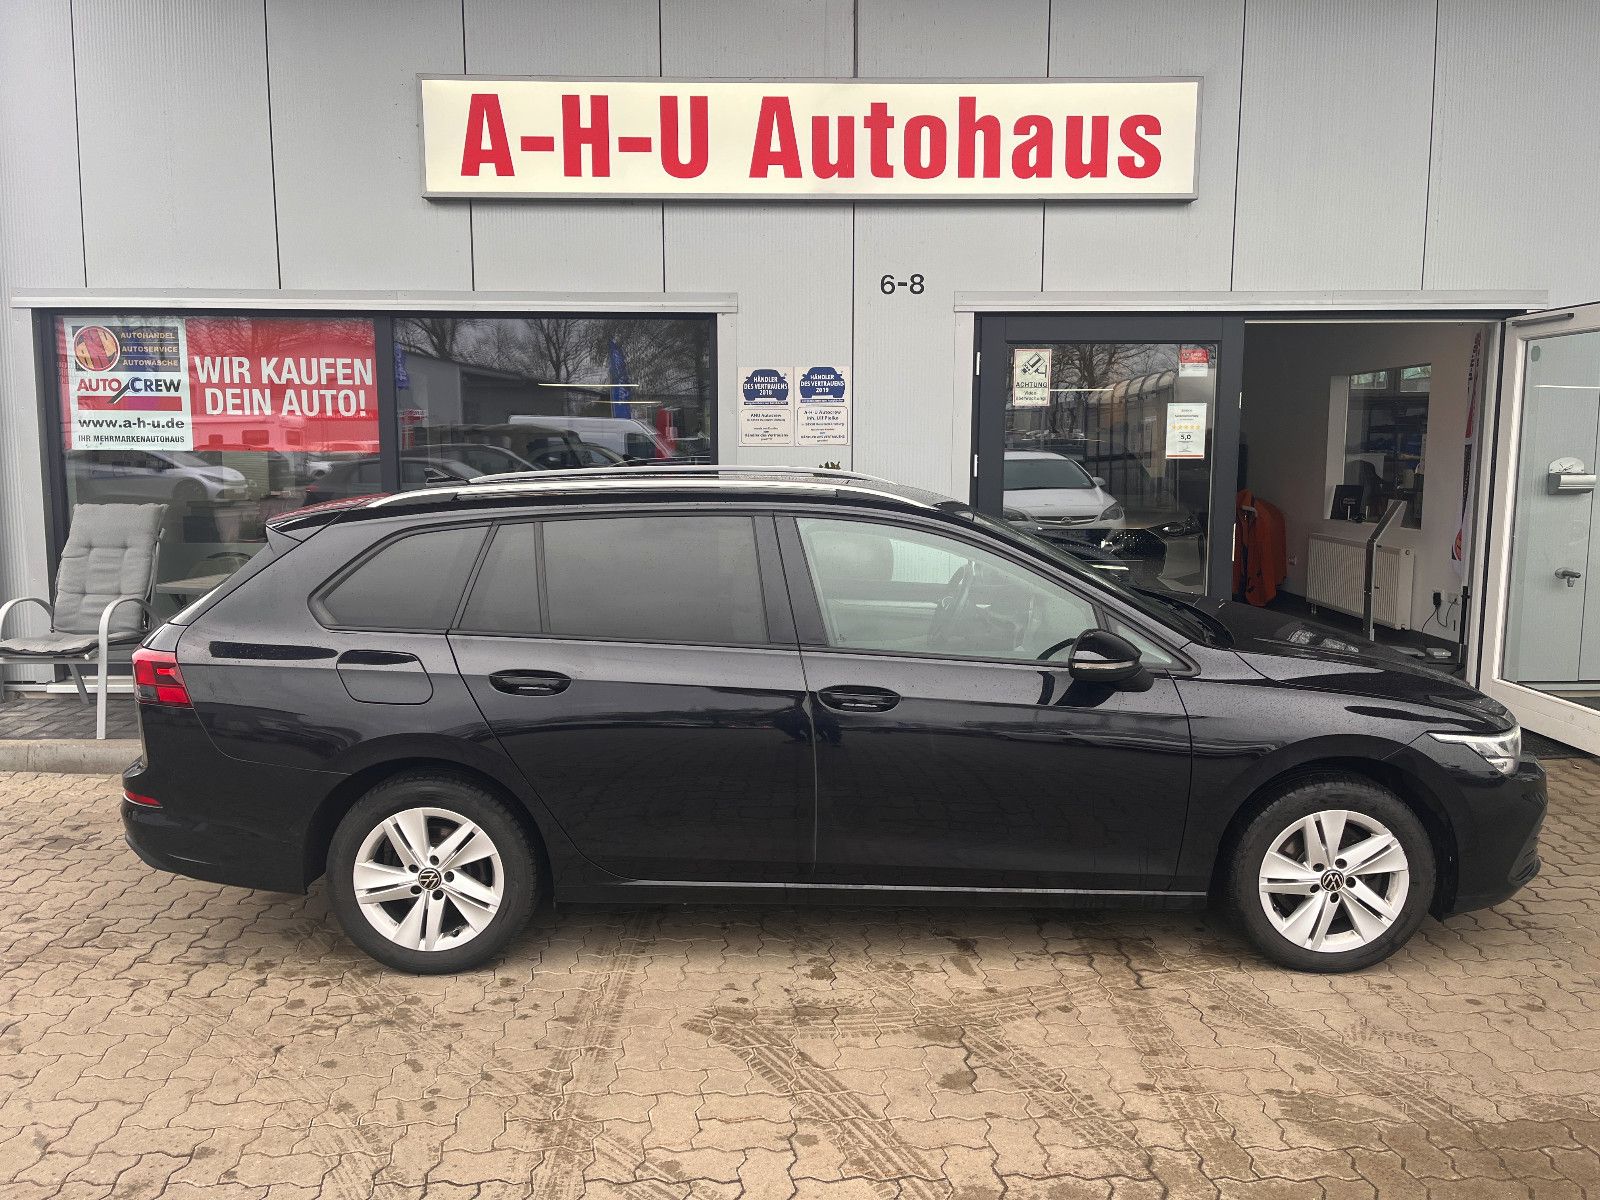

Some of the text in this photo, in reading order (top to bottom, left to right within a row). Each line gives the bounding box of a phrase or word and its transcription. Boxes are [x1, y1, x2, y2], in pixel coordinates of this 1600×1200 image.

[460, 93, 1162, 179] A-H-U Autohaus
[881, 274, 925, 294] 6-8
[194, 356, 252, 384] WIR
[260, 357, 373, 385] KAUFEN
[77, 377, 182, 392] AUTO CREW
[205, 388, 367, 417] DEIN AUTO!
[78, 417, 185, 429] www.a-h-u.de
[78, 434, 185, 443] IHR MEHRMARKENAUTOHAUS
